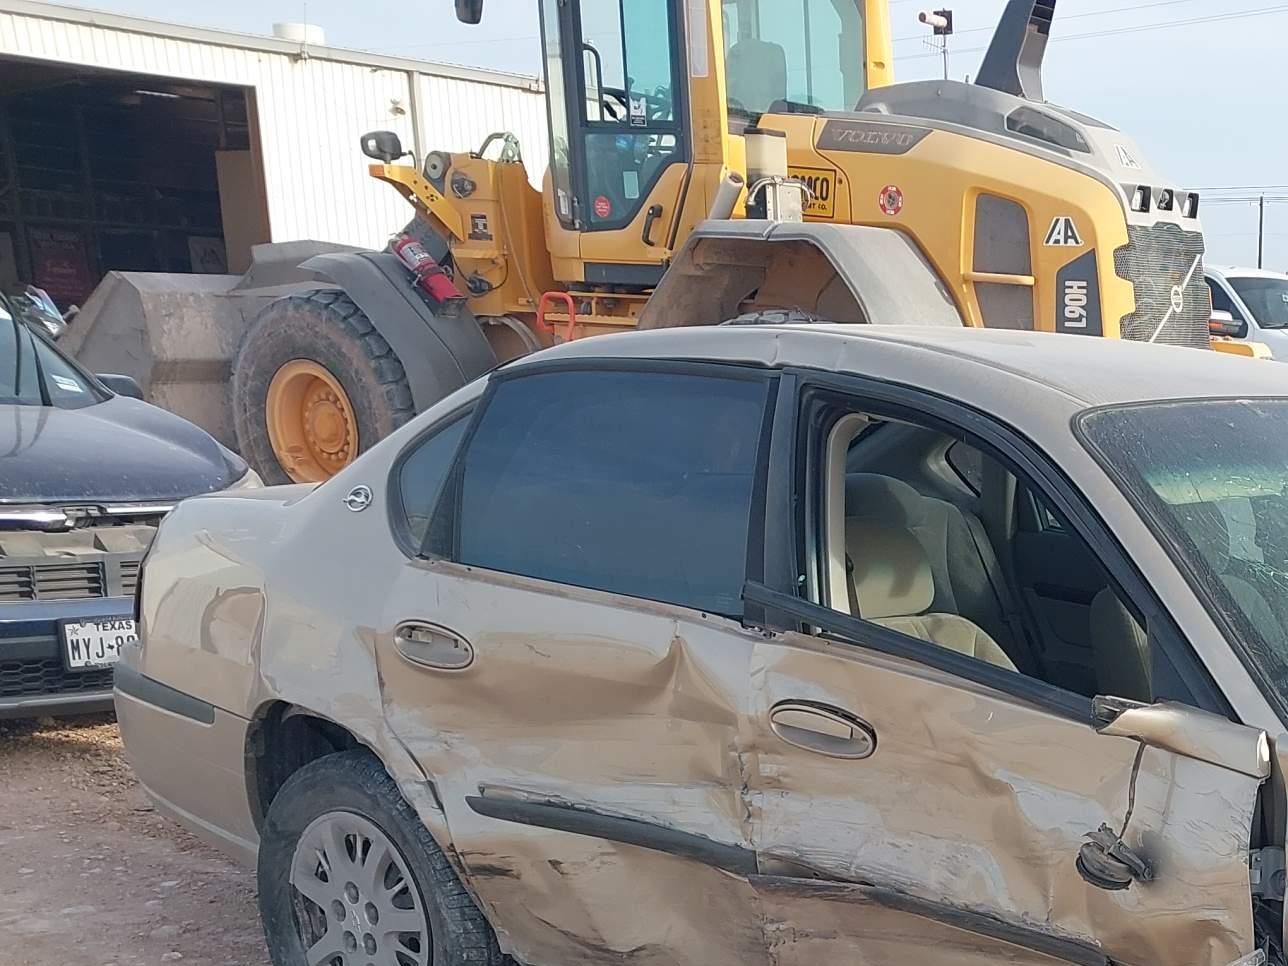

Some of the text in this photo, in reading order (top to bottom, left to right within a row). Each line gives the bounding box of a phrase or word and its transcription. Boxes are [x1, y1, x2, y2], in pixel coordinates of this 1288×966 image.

[831, 128, 914, 146] VOLVO
[1064, 280, 1087, 328] L90H
[94, 620, 133, 632] TEXAS
